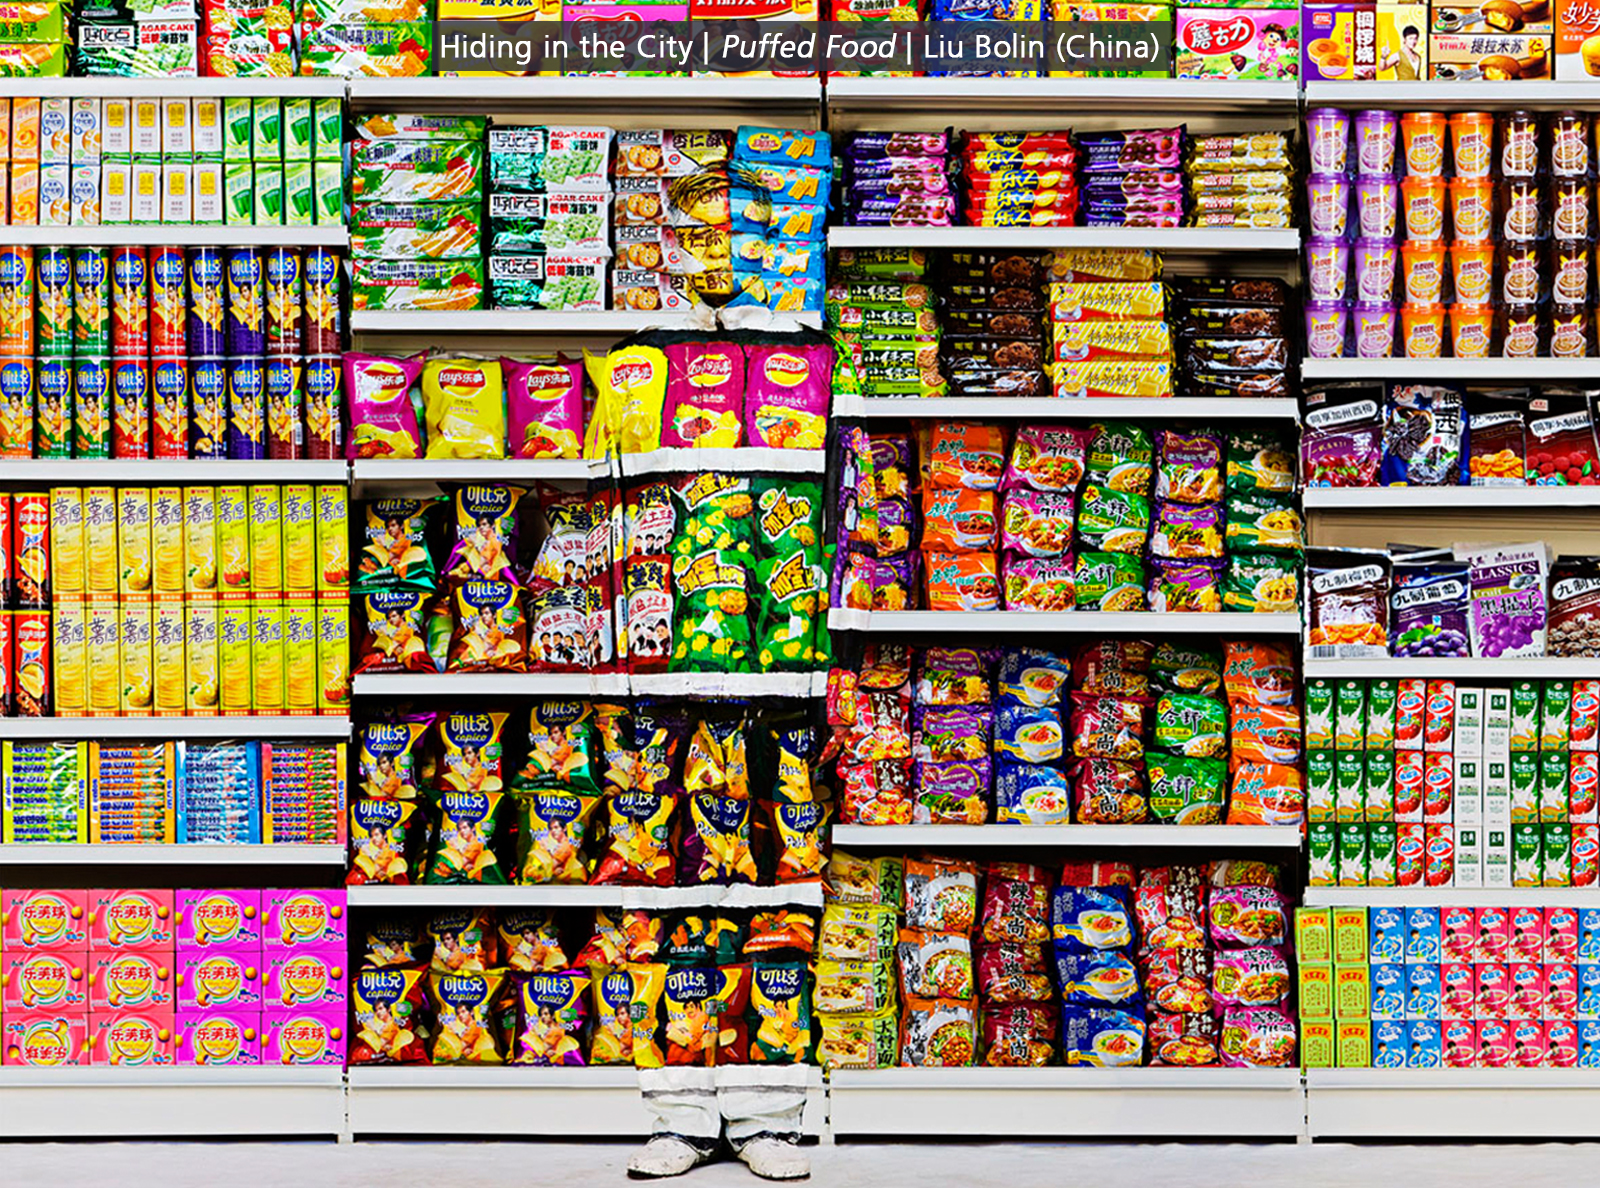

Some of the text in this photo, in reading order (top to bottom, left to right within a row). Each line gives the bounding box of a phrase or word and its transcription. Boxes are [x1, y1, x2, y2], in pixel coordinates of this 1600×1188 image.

[1470, 38, 1525, 54] 提拉米苏
[466, 485, 509, 504] 可比克
[1470, 562, 1537, 582] CLASSICS
[450, 714, 490, 732] 可比克
[368, 722, 407, 741] 可比克
[24, 905, 67, 918] 乐芙球
[198, 905, 239, 918] 乐芙球
[283, 905, 326, 918] 乐芙球
[24, 967, 67, 980] 乐芙球
[110, 967, 152, 980] 乐芙球
[283, 967, 326, 980] 乐芙球
[361, 971, 402, 990] 可比克
[443, 976, 484, 994] 可比克
[111, 1028, 153, 1041] 乐芙球
[198, 1028, 239, 1041] 乐芙球
[283, 1028, 326, 1041] 乐芙球
